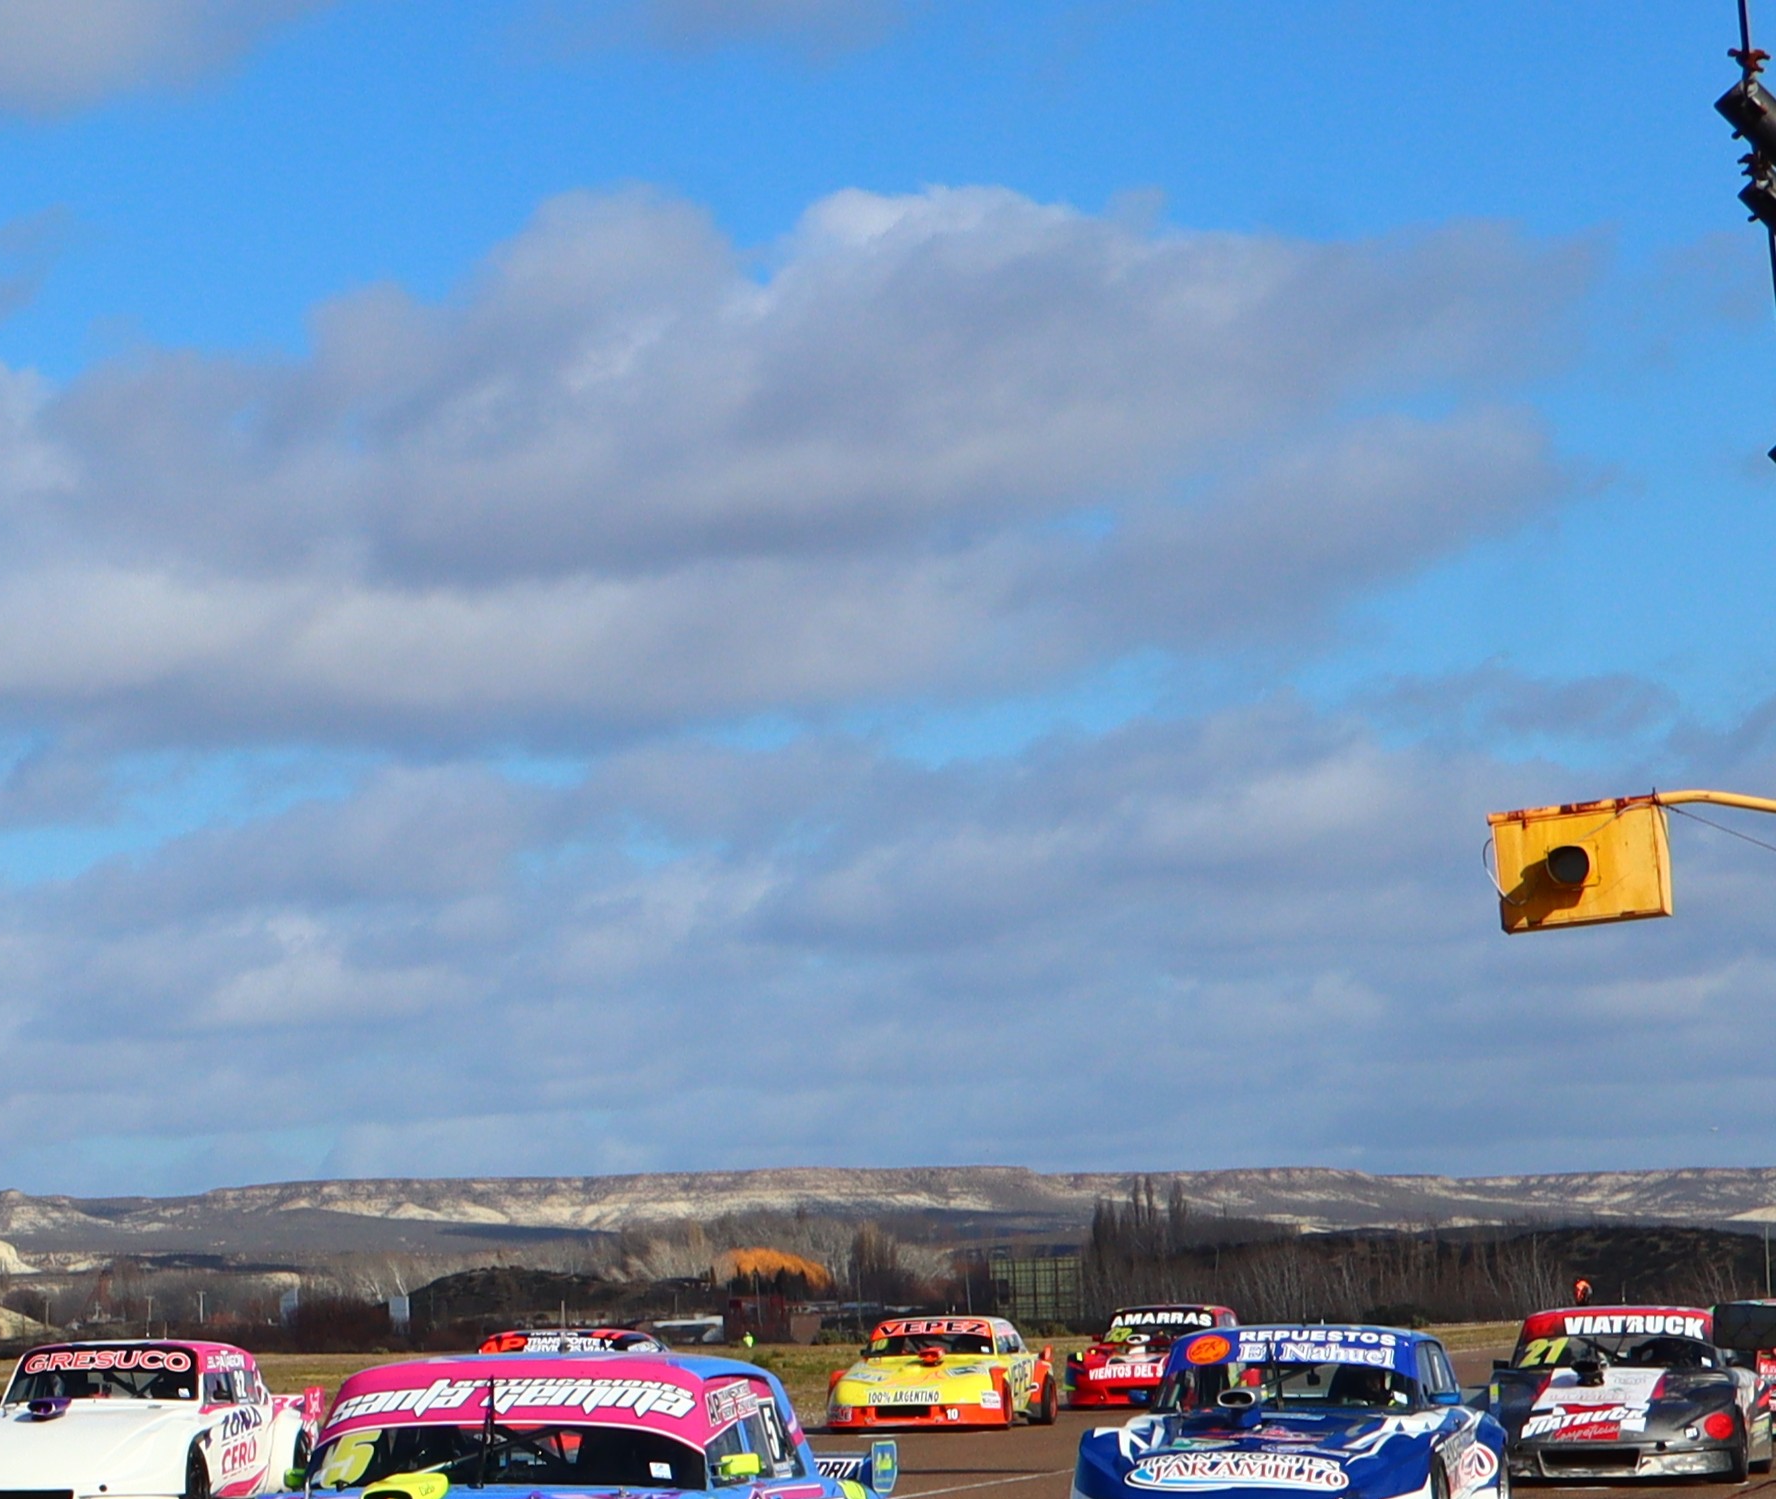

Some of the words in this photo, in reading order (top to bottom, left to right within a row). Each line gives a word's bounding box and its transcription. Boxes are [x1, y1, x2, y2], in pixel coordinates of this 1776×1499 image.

[879, 1321, 988, 1336] VEPEZ
[1111, 1312, 1212, 1328] AMARRAS
[1564, 1315, 1704, 1340] VIATRUCK
[1239, 1330, 1396, 1346] REPUESTOS
[25, 1350, 191, 1374] GRESUCO
[1279, 1343, 1395, 1369] Nahuel
[1519, 1338, 1569, 1368] 21
[1089, 1364, 1132, 1380] VIENTOS
[1134, 1364, 1154, 1378] DEL
[454, 1378, 693, 1398] RECTIFICACIONES
[868, 1392, 890, 1403] 100%
[893, 1390, 940, 1403] ARGENTINO
[222, 1406, 262, 1440] ZONA
[946, 1408, 958, 1420] 10
[1521, 1407, 1647, 1439] VIATRUCK
[763, 1407, 780, 1459] 5
[222, 1436, 257, 1474] CERO
[319, 1429, 382, 1488] 5
[1151, 1461, 1348, 1487] JARAMILLO
